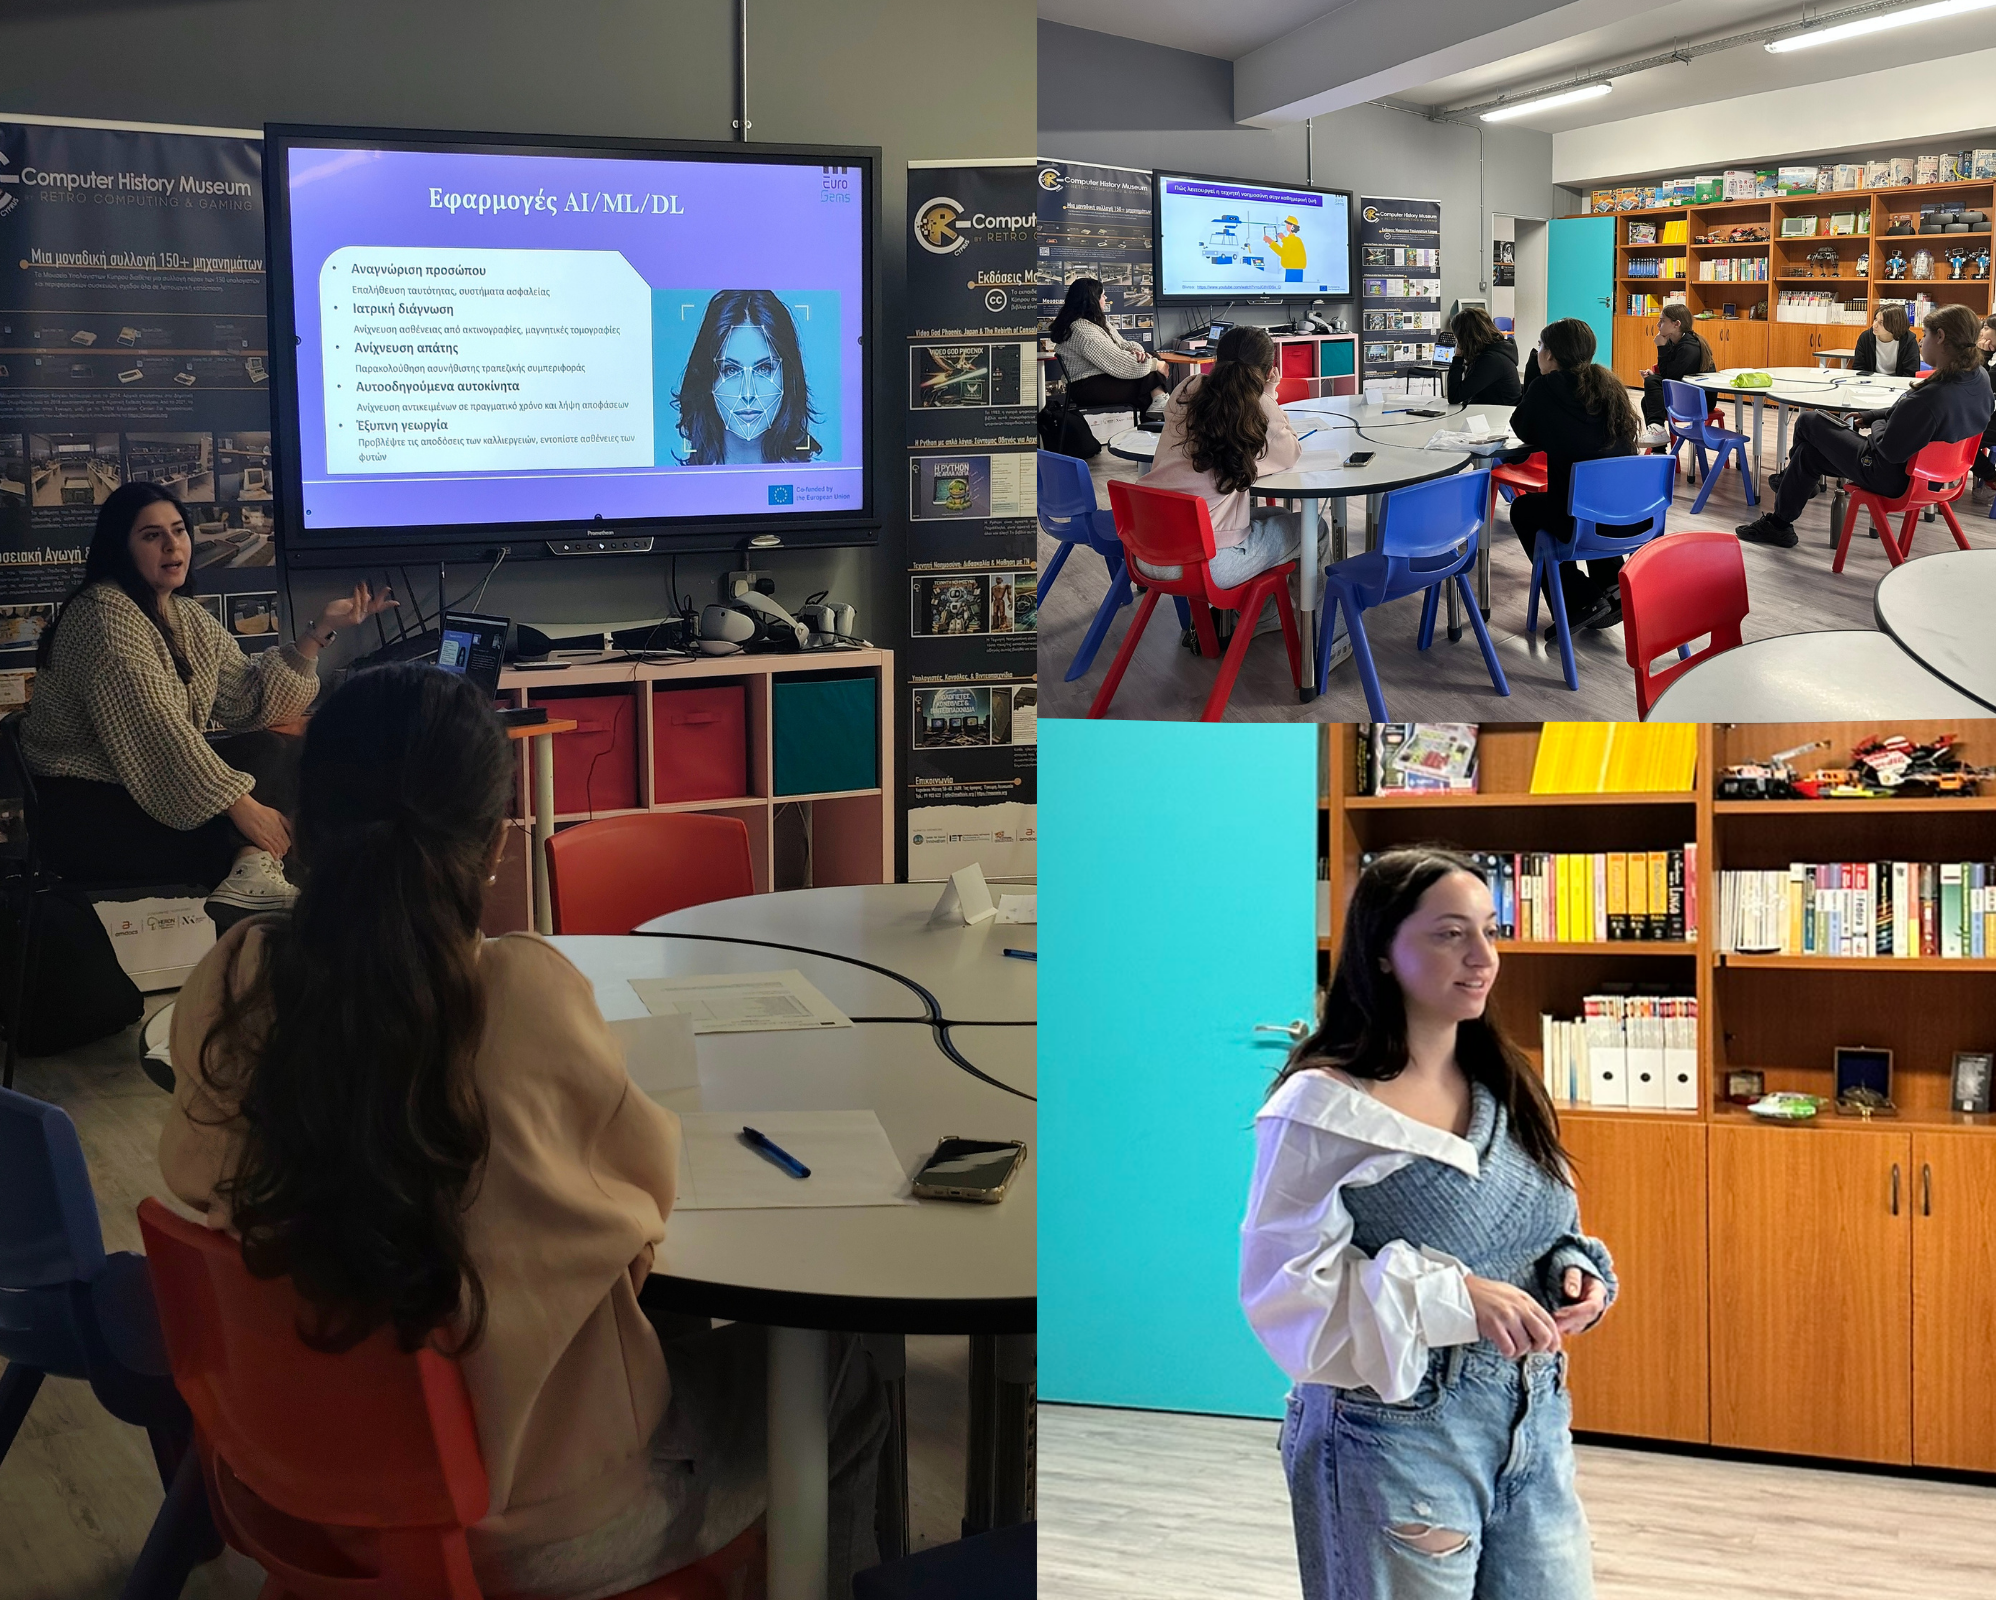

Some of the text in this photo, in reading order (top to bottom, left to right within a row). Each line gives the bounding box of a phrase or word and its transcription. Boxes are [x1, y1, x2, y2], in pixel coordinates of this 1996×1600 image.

[21, 167, 252, 196] Computer History Museum
[822, 176, 848, 189] Euro
[1064, 176, 1148, 191] Computer History Museum
[820, 190, 851, 203] Gems
[1174, 184, 1187, 192] Πώς
[1187, 186, 1215, 195] λειτουργεί
[0, 197, 19, 217] CYPRUS
[40, 191, 252, 211] RETRO COMPUTING & GAMING
[428, 187, 685, 216] Εφαρμογές AI/ML/DL
[972, 211, 1037, 231] Comput
[987, 231, 1027, 242] RETRO
[954, 239, 970, 257] CYPRUS
[31, 248, 263, 273] Μια μοναδική συλλογή 150+ μηχανημάτων
[351, 262, 487, 278] Αναγνώριση προσώπου
[977, 270, 1022, 286] Εκδόσεις
[352, 285, 551, 298] Επαλήθευση ταυτότητας, συστήματα ασφαλείας
[352, 302, 454, 317] Ιατρική διάγνωση
[353, 324, 621, 336] Ανίχνευση ασθένειας από ακτινογραφίες, μαγνητικές τομογραφίες
[931, 328, 940, 336] God
[964, 328, 978, 336] Japan
[354, 342, 459, 356] Ανίχνευση απάτης
[355, 363, 586, 374] Παρακολούθηση ασυνήθιστης τραπεζικής συμπεριφοράς
[356, 380, 520, 394] Αυτοοδηγούμενα αυτοκίνητα
[357, 401, 629, 413] Ανίχνευση αντικειμένων σε πραγματικό χρόνο και λήψη αποφάσεων
[356, 419, 449, 433] Έξυπνη γεωργία
[358, 433, 636, 449] Προβλέψτε τις αποδόσεις των καλλιεργειών, εντοπίστε ασθένειες των
[920, 439, 937, 447] Python
[358, 452, 387, 463] φυτών
[941, 462, 970, 473] PYTHON
[806, 493, 833, 502] European
[834, 492, 850, 501] Union
[45, 546, 82, 565] Αγωγή
[915, 775, 954, 784] Επικοινωνία
[1669, 887, 1684, 914] LINGO
[1855, 897, 1865, 926] Fedora
